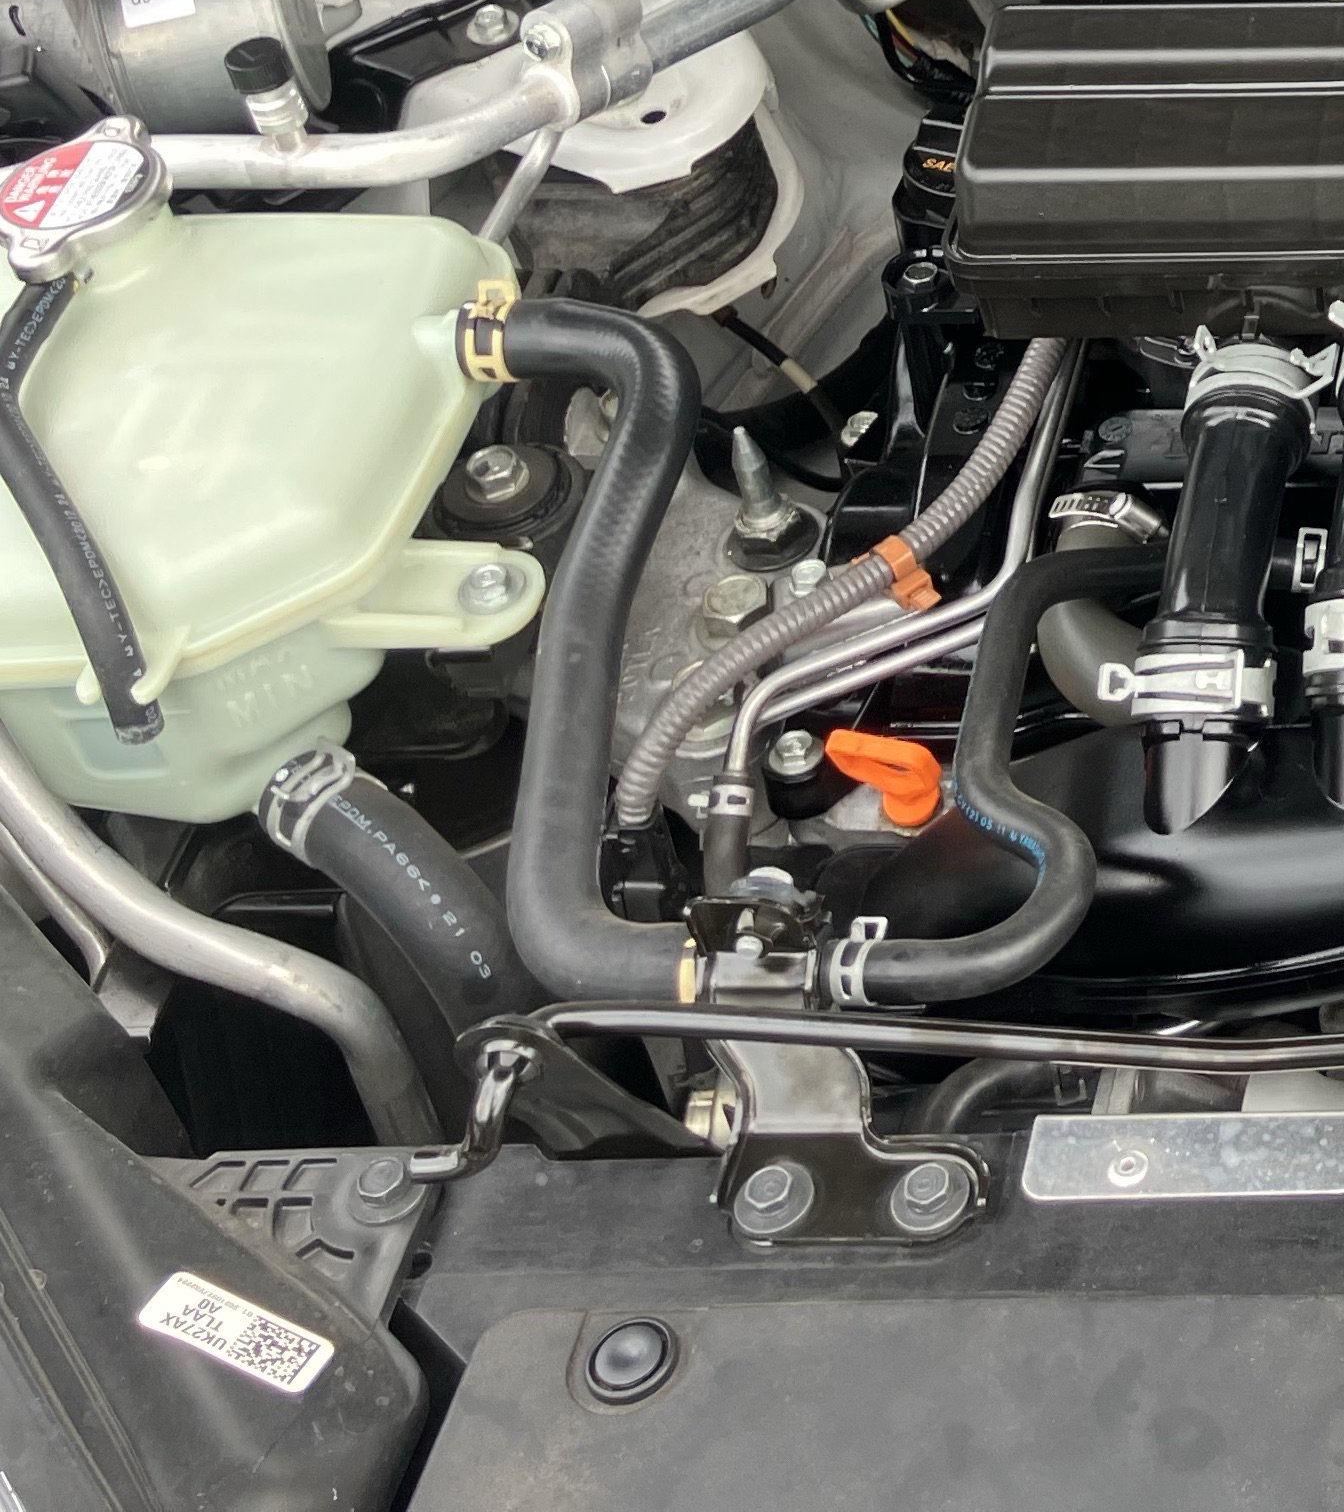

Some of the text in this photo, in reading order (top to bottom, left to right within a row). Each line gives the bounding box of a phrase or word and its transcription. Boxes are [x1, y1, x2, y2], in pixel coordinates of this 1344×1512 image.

[226, 663, 314, 729] MIN
[469, 949, 493, 980] 03
[159, 1311, 228, 1352] UK27AX
[180, 1302, 224, 1333] TLAA
